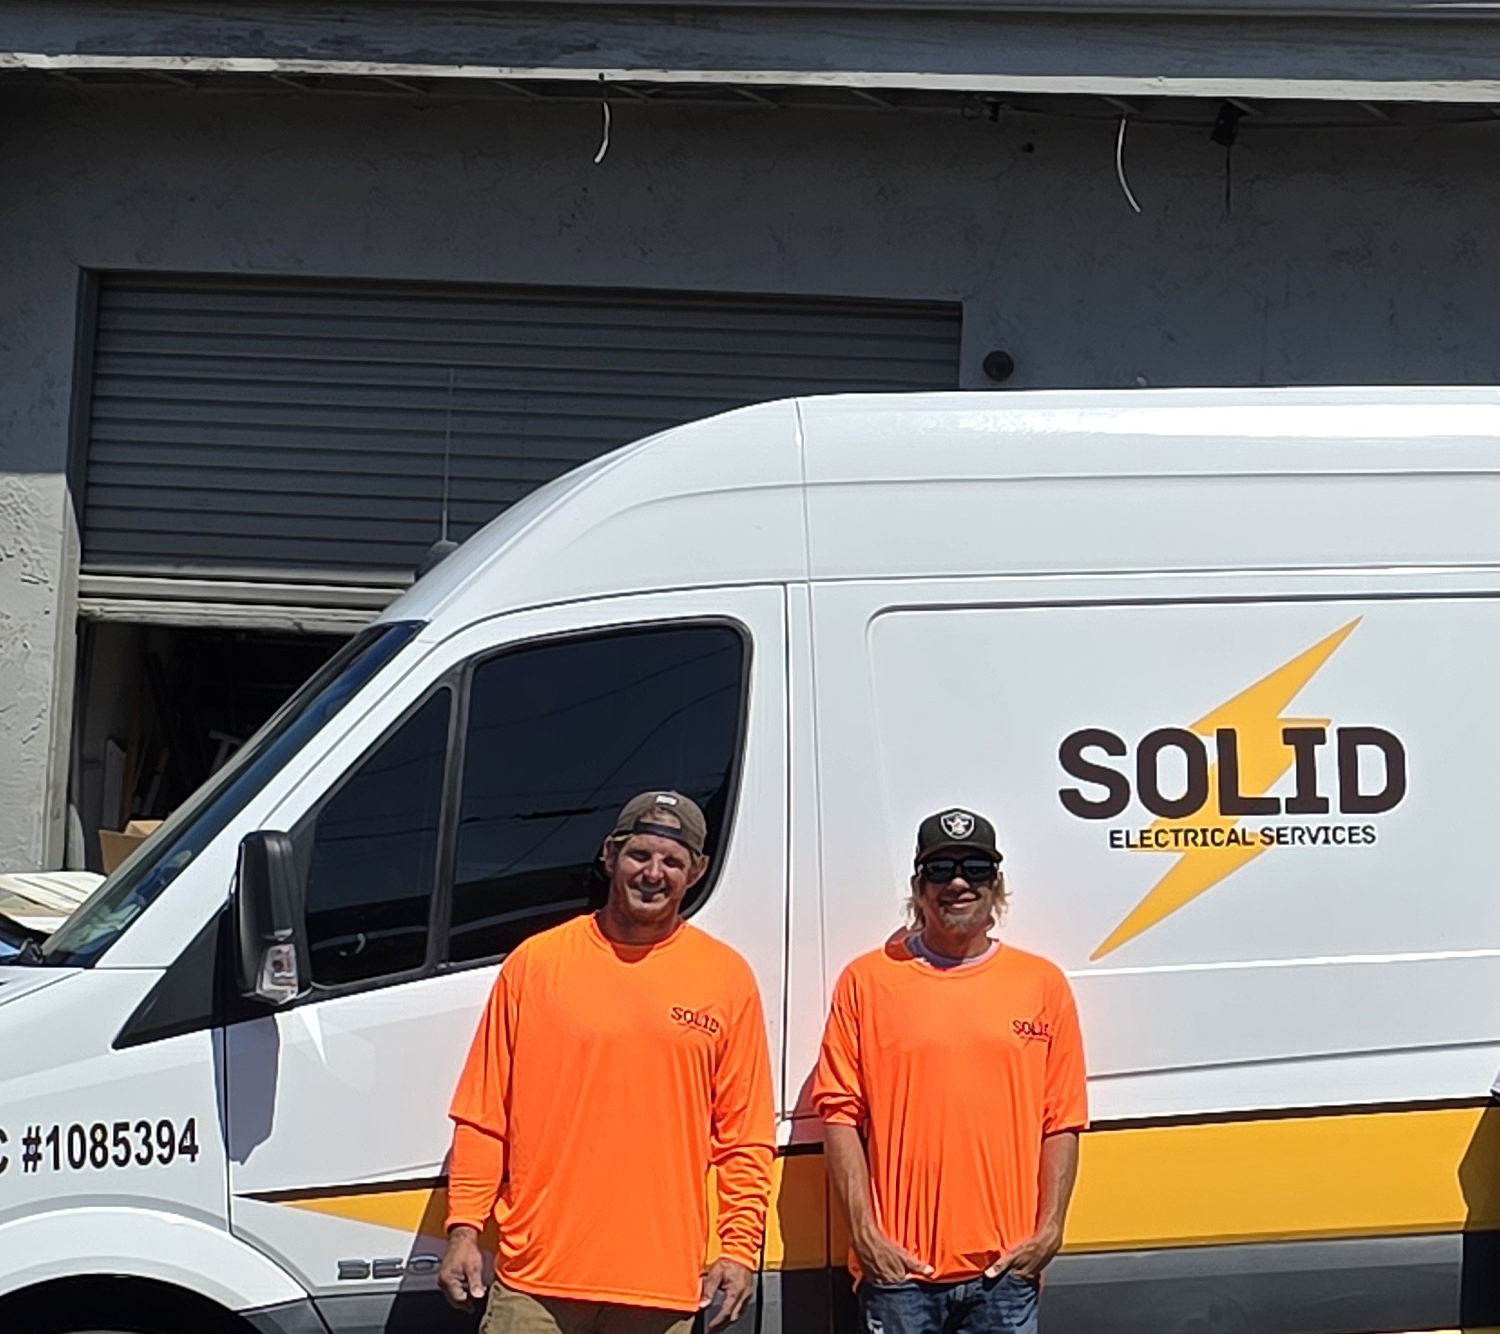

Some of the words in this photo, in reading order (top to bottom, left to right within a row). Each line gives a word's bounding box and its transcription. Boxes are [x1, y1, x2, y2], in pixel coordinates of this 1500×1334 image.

[1058, 726, 1407, 820] SOLID
[1108, 827, 1255, 849] ELECTRICAL
[1259, 825, 1377, 846] SERVICES
[670, 1006, 720, 1034] SOLID
[22, 1117, 200, 1173] #1085394
